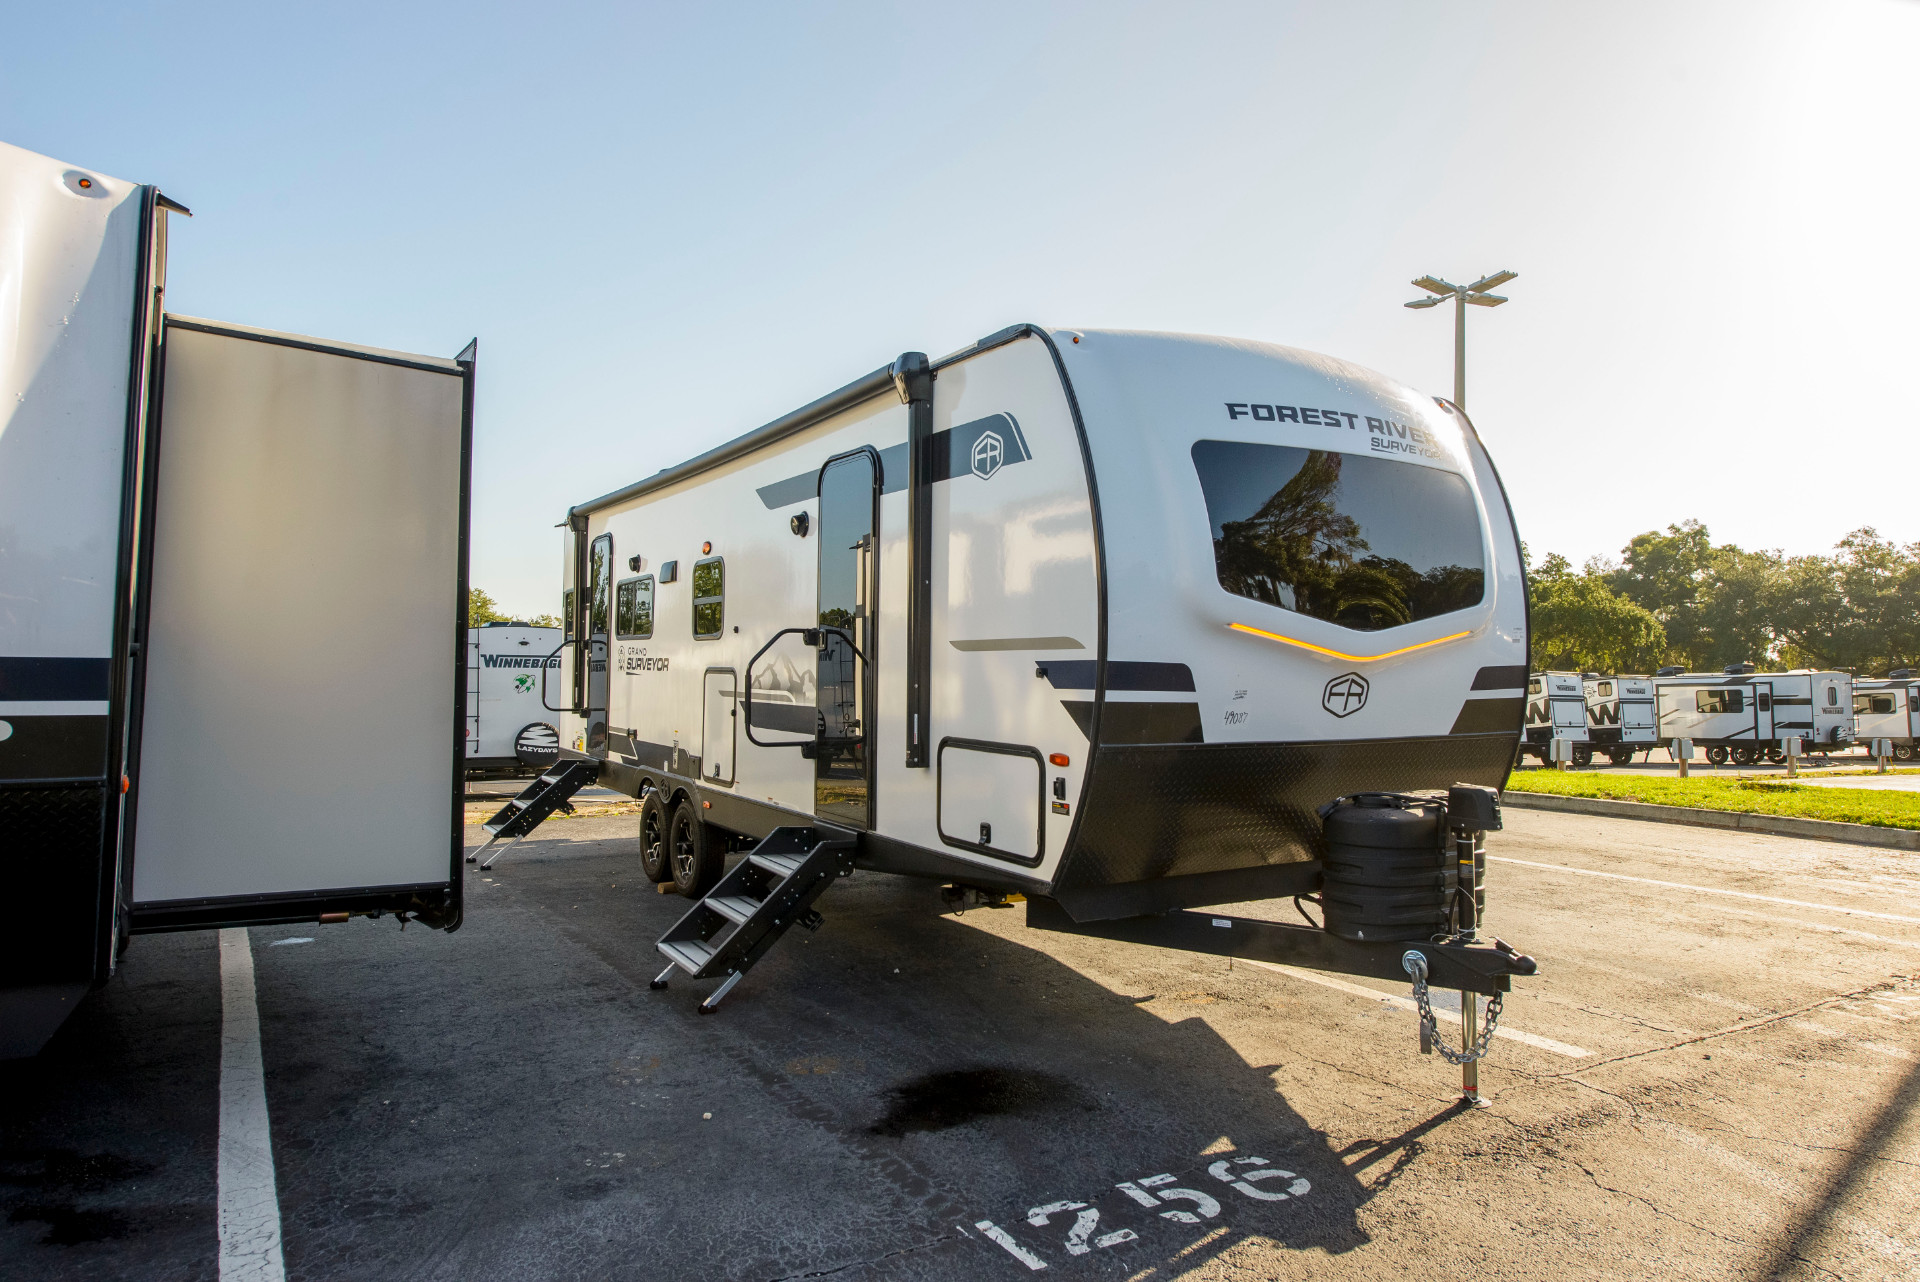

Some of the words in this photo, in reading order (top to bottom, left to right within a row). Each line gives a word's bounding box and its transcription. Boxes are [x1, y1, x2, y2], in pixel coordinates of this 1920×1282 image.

[1224, 402, 1359, 430] FOREST
[1364, 416, 1440, 450] RIVER
[1370, 436, 1441, 460] SURVEYOR
[627, 646, 647, 657] GRAND
[626, 657, 670, 672] SURVEYOR
[517, 744, 558, 753] LAZYDAYS
[956, 1156, 1312, 1271] 1256
